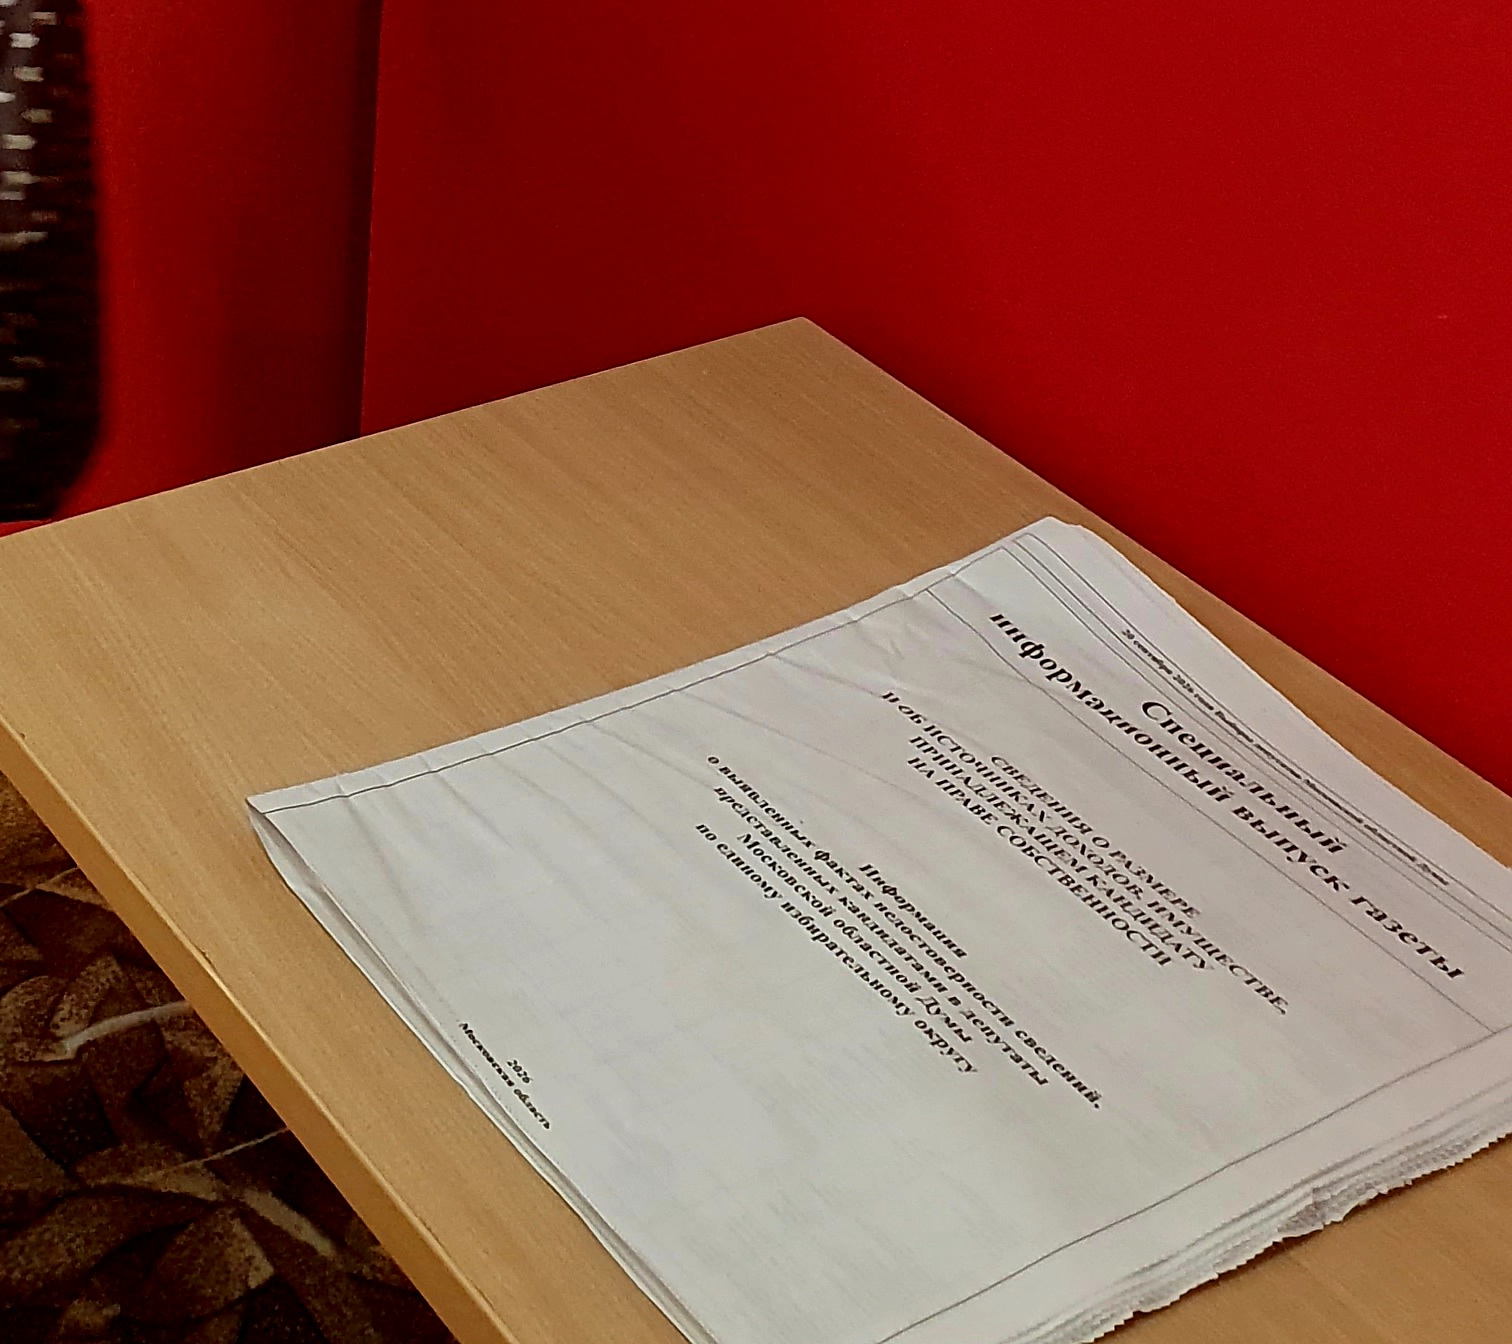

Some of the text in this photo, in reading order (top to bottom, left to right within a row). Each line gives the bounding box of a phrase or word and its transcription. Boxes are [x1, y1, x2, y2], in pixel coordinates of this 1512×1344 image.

[898, 705, 927, 724] ОБ
[922, 724, 1051, 823] ИСТОЧНИКАХ
[907, 757, 1172, 965] НА ПРАВЕ СОБСТВЕННОСТИ
[908, 736, 1214, 969] ПРИНАДЛЕЖАЩЕМ КАНДИДАТУ
[989, 613, 1464, 978] информационный выпуск газеты
[991, 756, 1200, 918] СВЕДЕНИЯ О РАЗМЕРЕ
[1141, 701, 1354, 853] Специальный
[695, 824, 977, 1072] по единому избирательному округу
[707, 756, 719, 764] о
[718, 766, 816, 848] выявленных
[813, 847, 874, 900] фактах
[872, 901, 1014, 1027] недостоверности
[712, 787, 1048, 1085] представленных кандидатами в депутаты
[736, 833, 973, 1042] Московской областной Думы
[857, 863, 967, 958] Информация
[458, 1022, 549, 1129] Московская область
[506, 1059, 532, 1083] 2026
